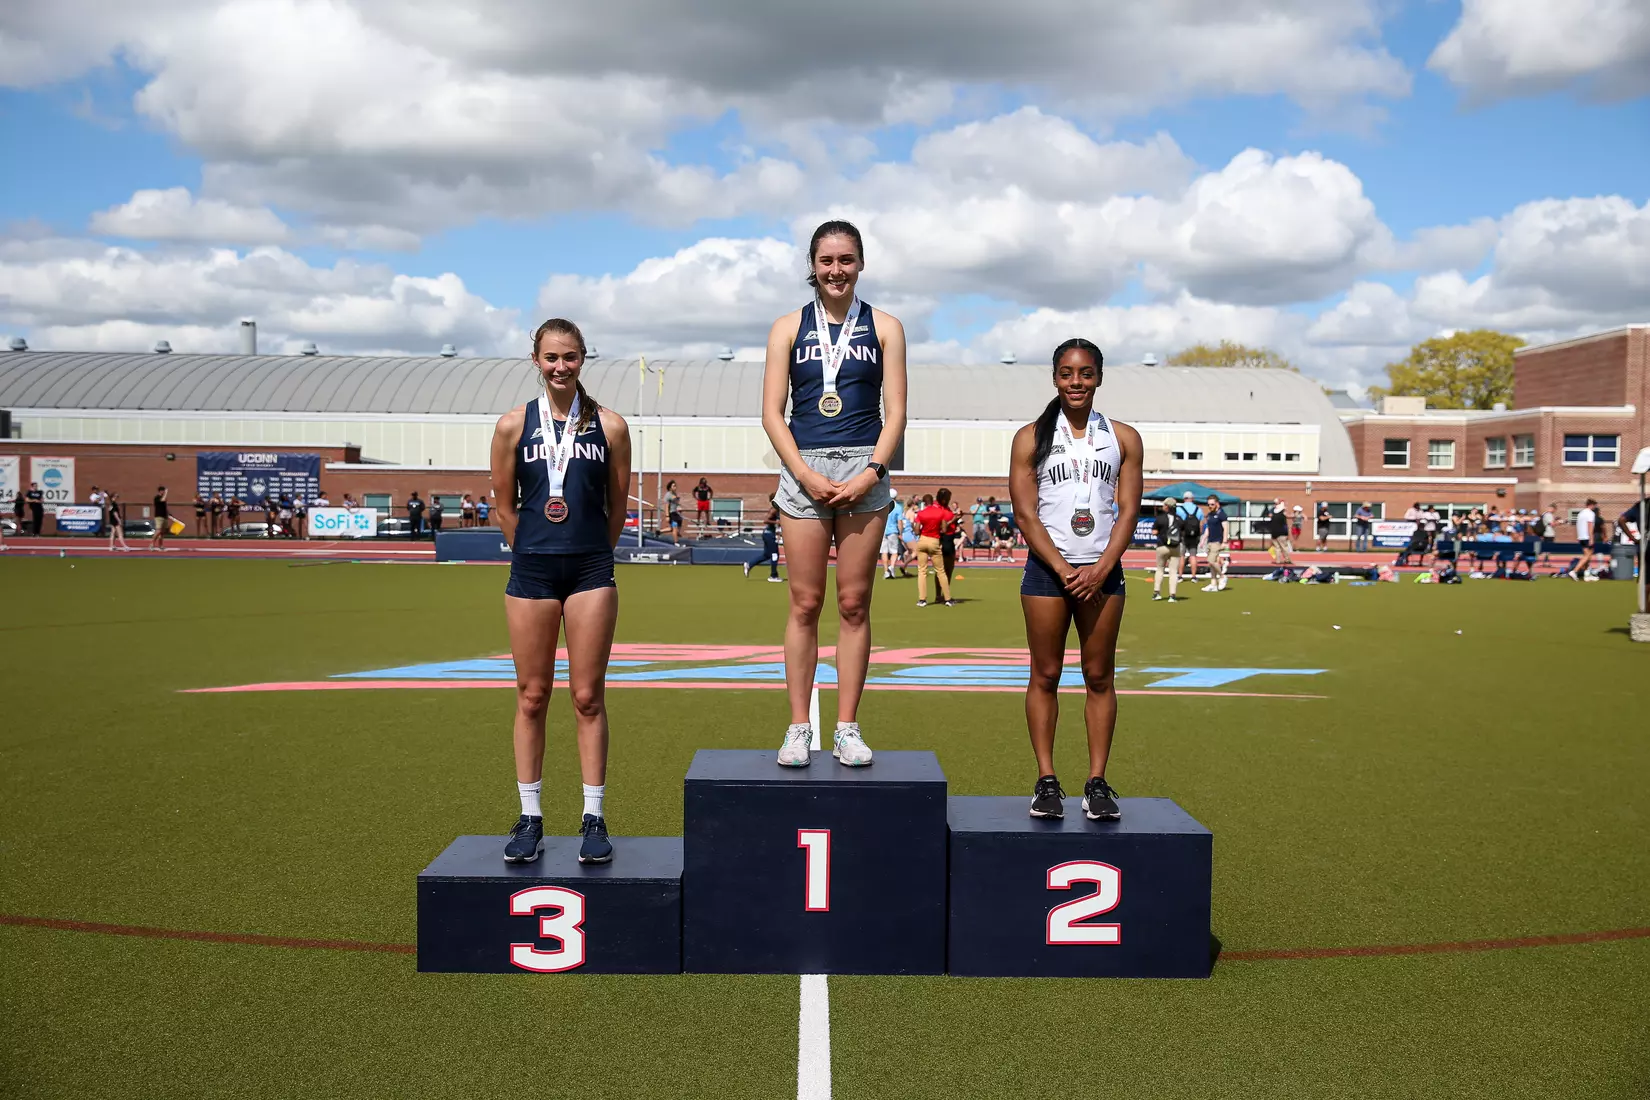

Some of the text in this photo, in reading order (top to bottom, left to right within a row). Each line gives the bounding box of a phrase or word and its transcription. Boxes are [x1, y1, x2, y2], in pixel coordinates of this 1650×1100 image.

[238, 453, 278, 463] UCONN
[314, 513, 350, 530] SoFi
[329, 659, 1329, 687] EAST
[798, 828, 831, 911] 1
[509, 885, 585, 973] 3
[1046, 860, 1121, 945] 2
